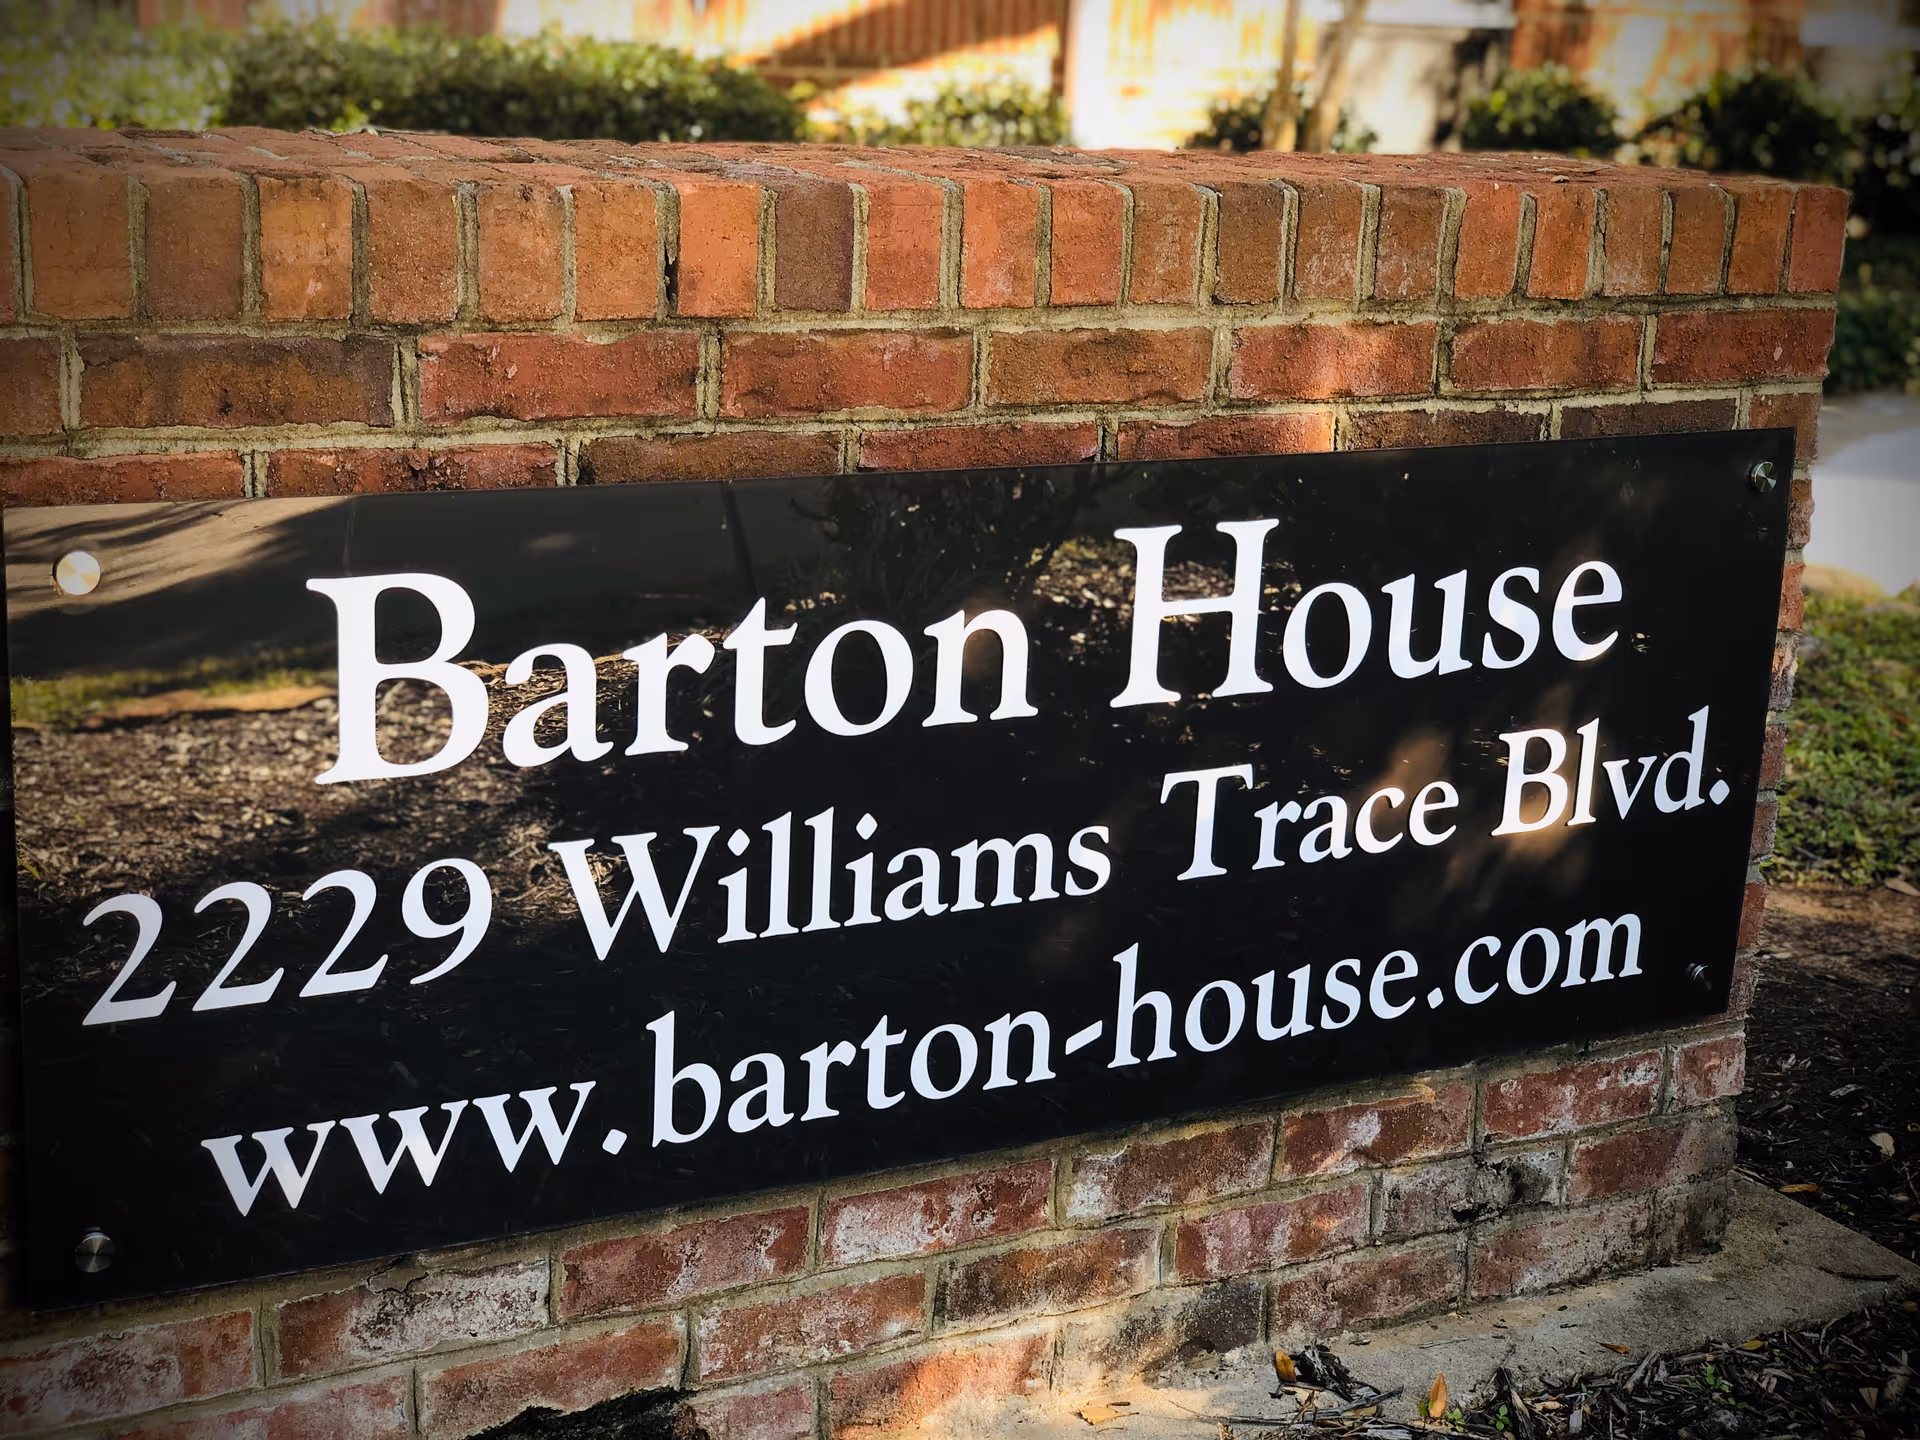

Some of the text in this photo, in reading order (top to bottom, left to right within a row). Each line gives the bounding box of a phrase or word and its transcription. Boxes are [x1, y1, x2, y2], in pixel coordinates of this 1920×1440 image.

[305, 518, 1624, 786] Barton House
[82, 705, 1730, 1026] 2229 Williams Trace Blvd.
[200, 912, 1643, 1218] www.barton-house.com
